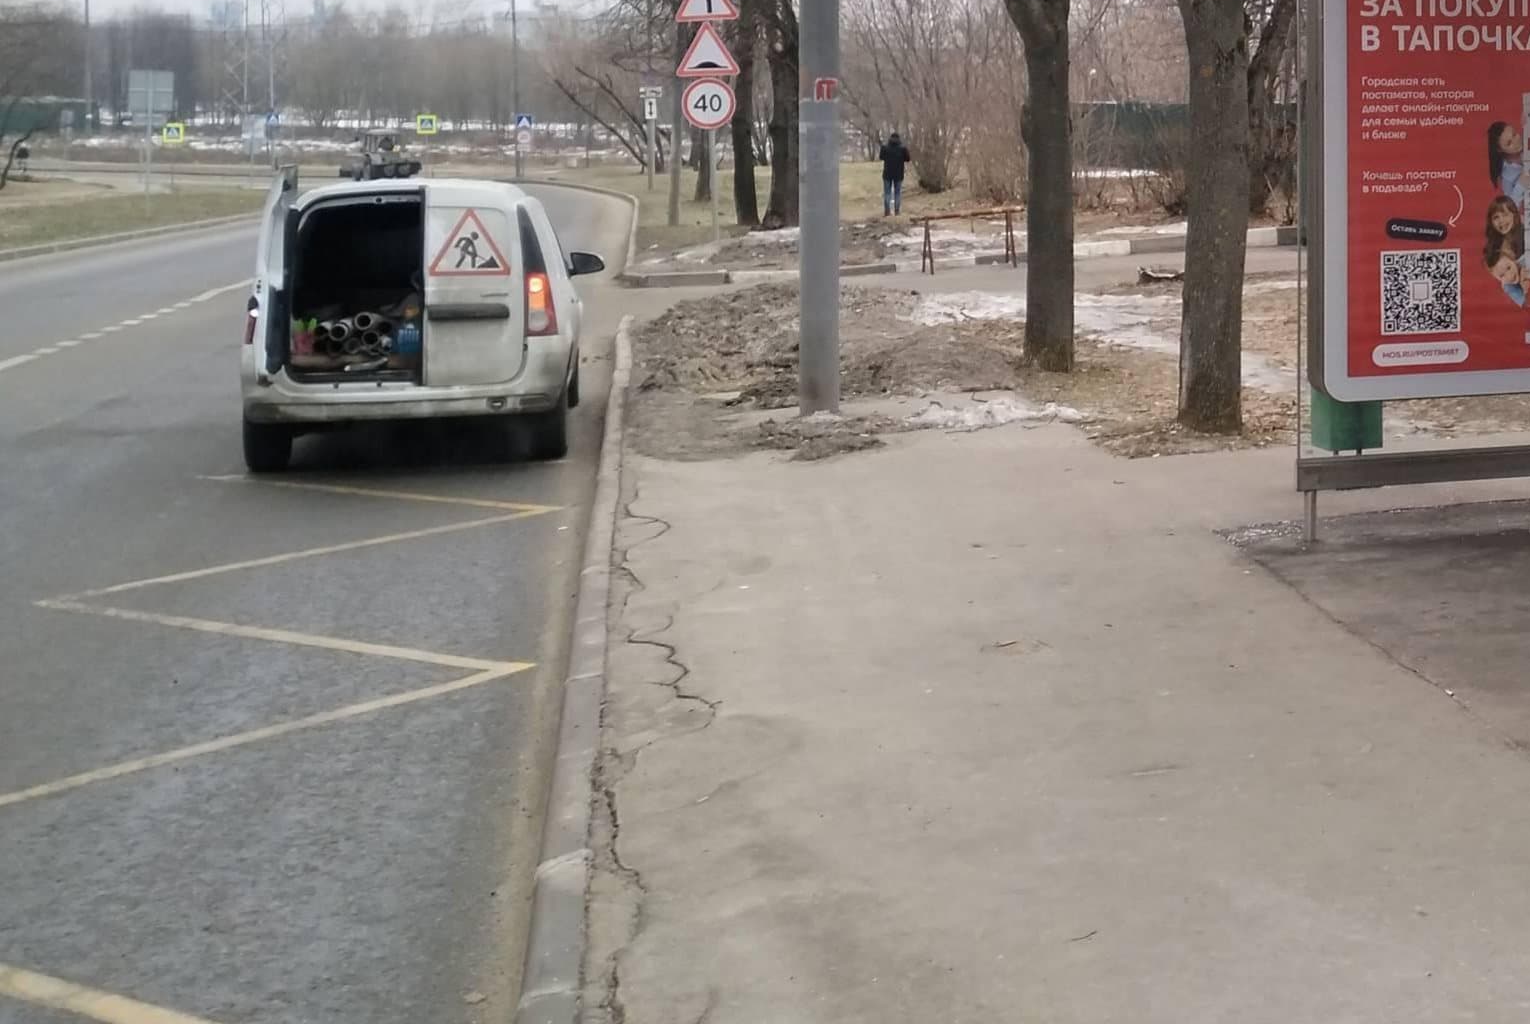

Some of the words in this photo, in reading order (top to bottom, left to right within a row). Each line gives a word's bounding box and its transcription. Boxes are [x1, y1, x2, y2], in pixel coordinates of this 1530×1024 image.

[1361, 25, 1380, 52] В
[1361, 76, 1419, 88] Городская
[1421, 77, 1445, 87] сеть
[1361, 90, 1429, 101] постаматов,
[1431, 90, 1475, 100] которая
[694, 93, 722, 112] 40
[1361, 104, 1400, 114] делает
[1401, 103, 1490, 114] онлайн-покупки
[1361, 117, 1381, 128] для
[1383, 116, 1417, 126] семьи
[1419, 115, 1464, 127] удобнее
[1361, 131, 1370, 140] и
[1371, 129, 1407, 140] ближе
[1362, 170, 1403, 181] Хочешь
[1406, 170, 1457, 180] постамат
[1362, 185, 1370, 193] в
[1371, 182, 1429, 194] подъезде?
